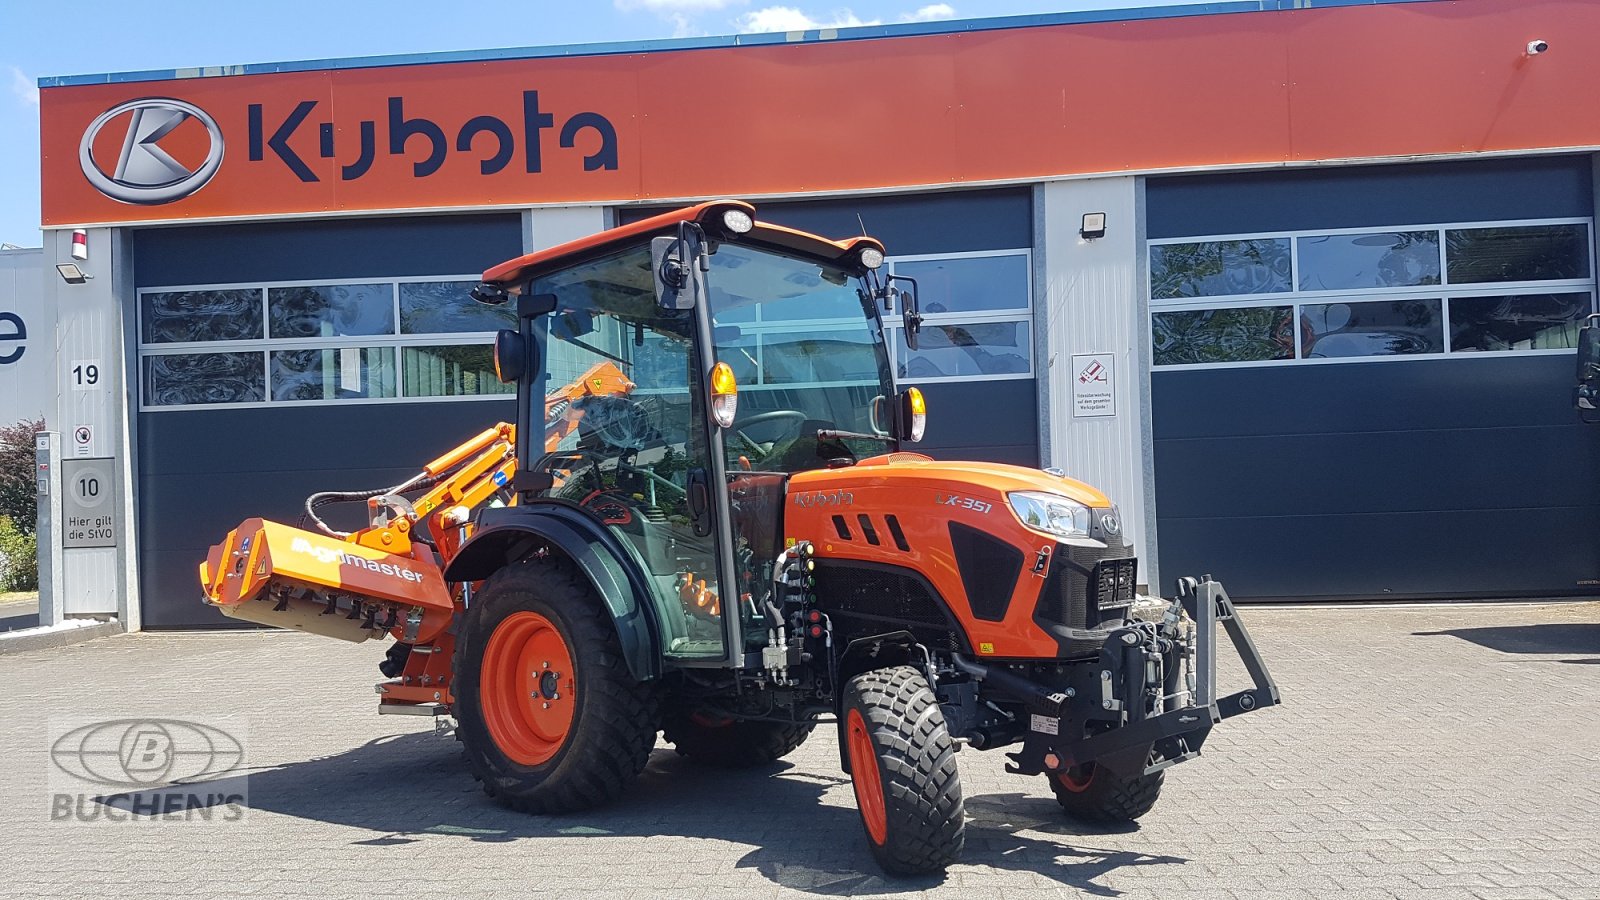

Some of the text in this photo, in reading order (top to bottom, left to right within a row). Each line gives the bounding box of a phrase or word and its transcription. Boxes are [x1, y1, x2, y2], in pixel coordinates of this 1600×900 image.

[247, 90, 618, 183] Kubota
[72, 364, 99, 385] 19
[79, 478, 99, 497] 10
[794, 488, 854, 508] Kubota
[935, 493, 992, 514] LX-351
[69, 515, 112, 529] Hier gilt
[69, 528, 113, 540] die StVO
